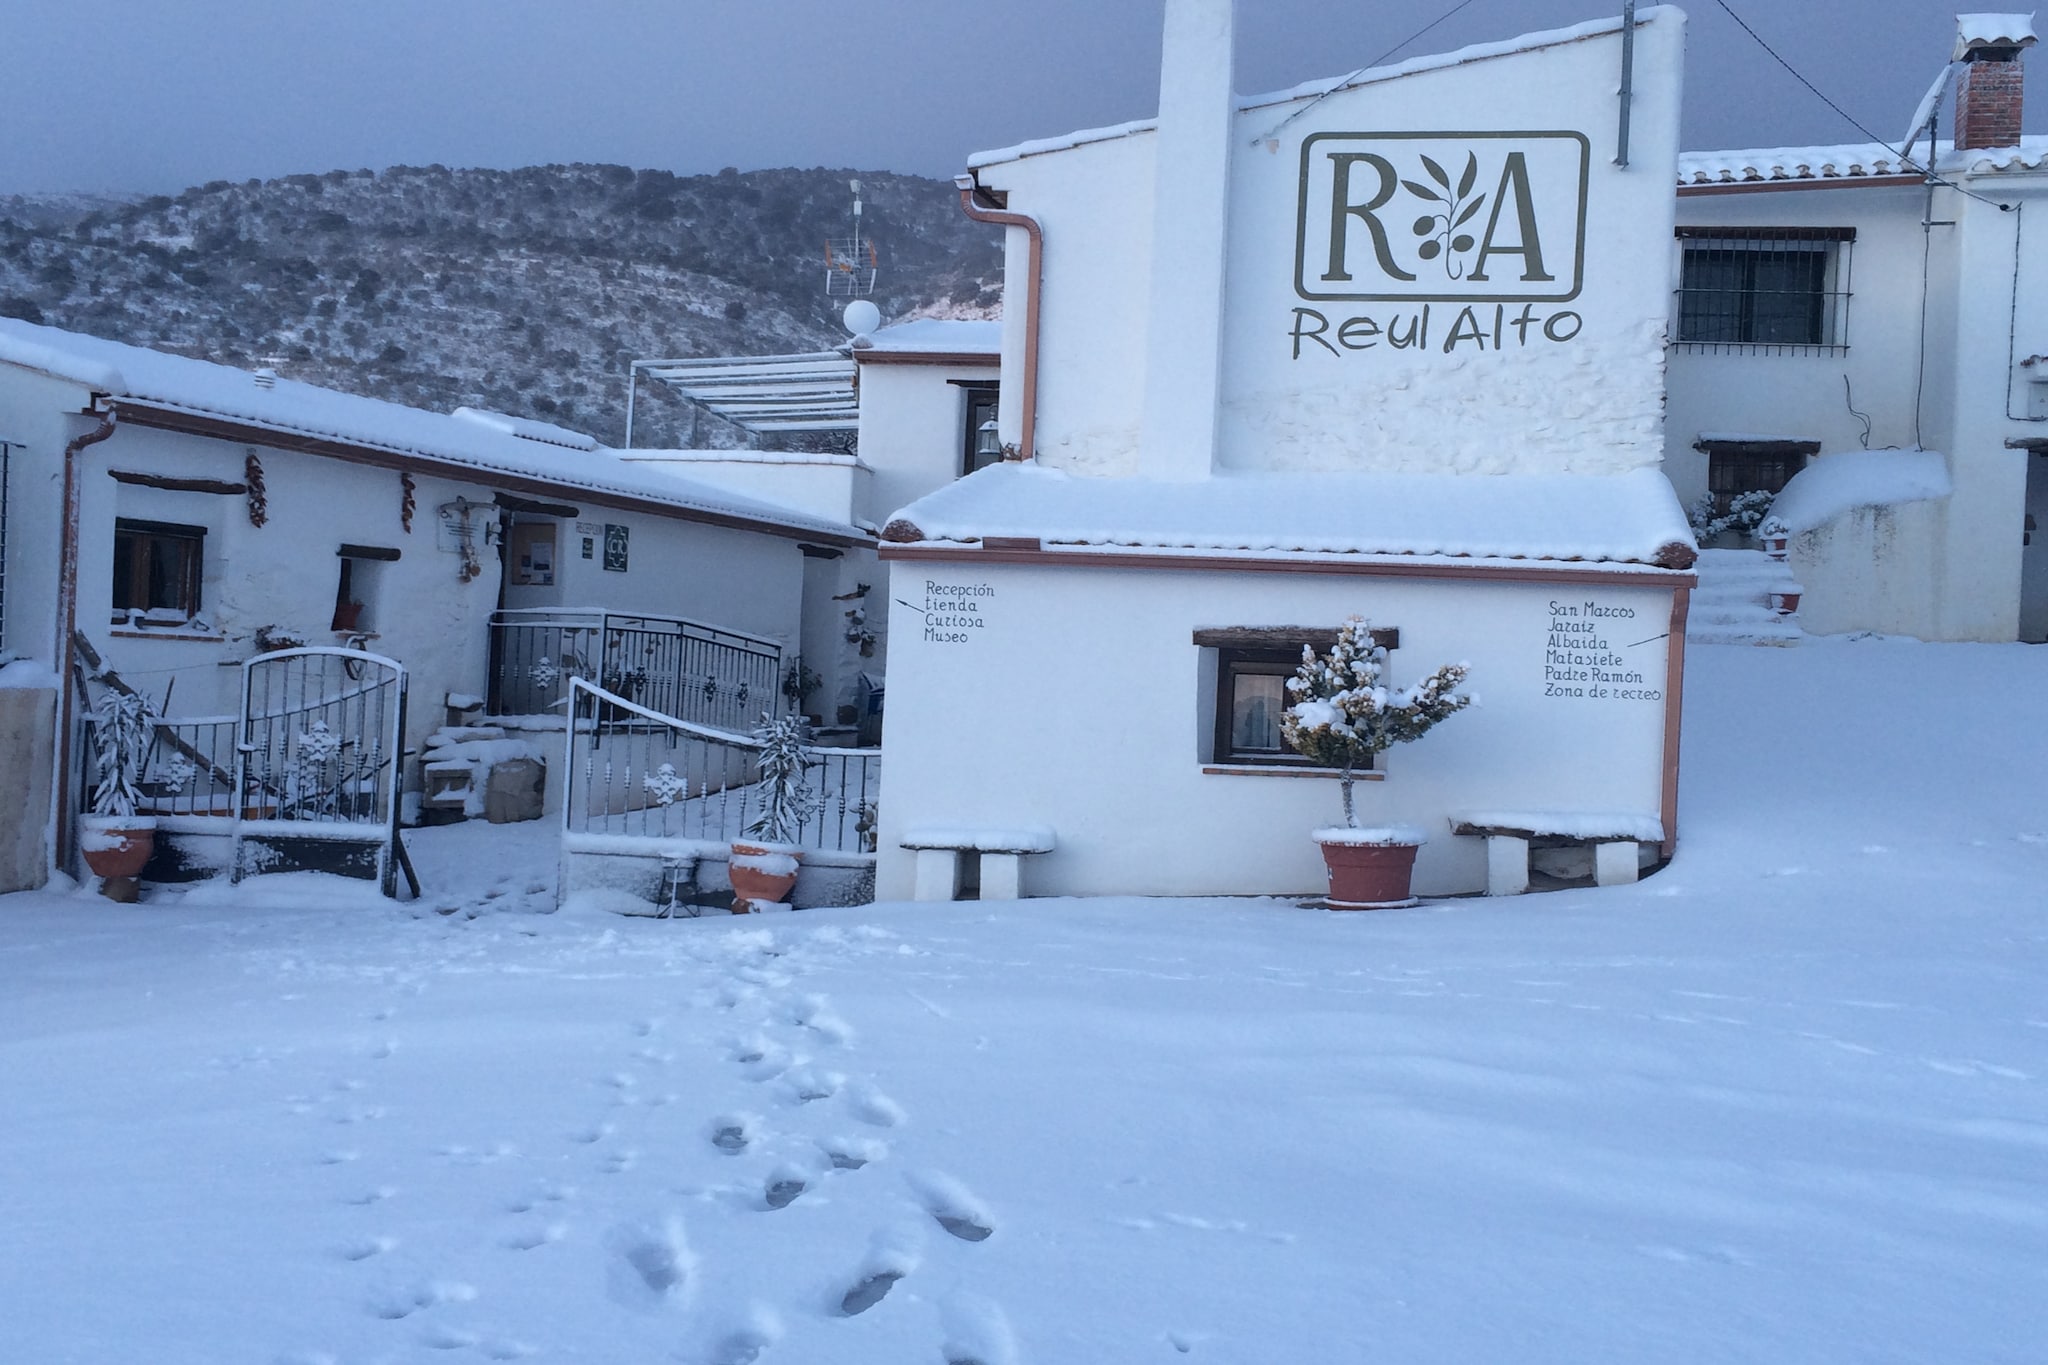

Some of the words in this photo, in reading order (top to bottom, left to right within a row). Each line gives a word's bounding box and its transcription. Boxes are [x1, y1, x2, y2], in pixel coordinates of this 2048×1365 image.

[1288, 303, 1430, 360] Reul
[1443, 303, 1583, 354] Alto
[925, 580, 995, 598] Recepción
[925, 596, 978, 612] tienda
[1548, 601, 1578, 617] San
[1584, 602, 1635, 618] Marcos
[925, 613, 985, 628] Curiosa
[1547, 617, 1595, 633] Jaraiz
[924, 628, 968, 643] Museo
[1547, 634, 1609, 650] Albaida
[1546, 650, 1623, 666] Matasiete
[1544, 666, 1588, 681] Padre
[1591, 668, 1643, 684] Ramón
[1545, 682, 1584, 698] Zona
[1588, 684, 1608, 699] de
[1613, 688, 1661, 701] recreo
